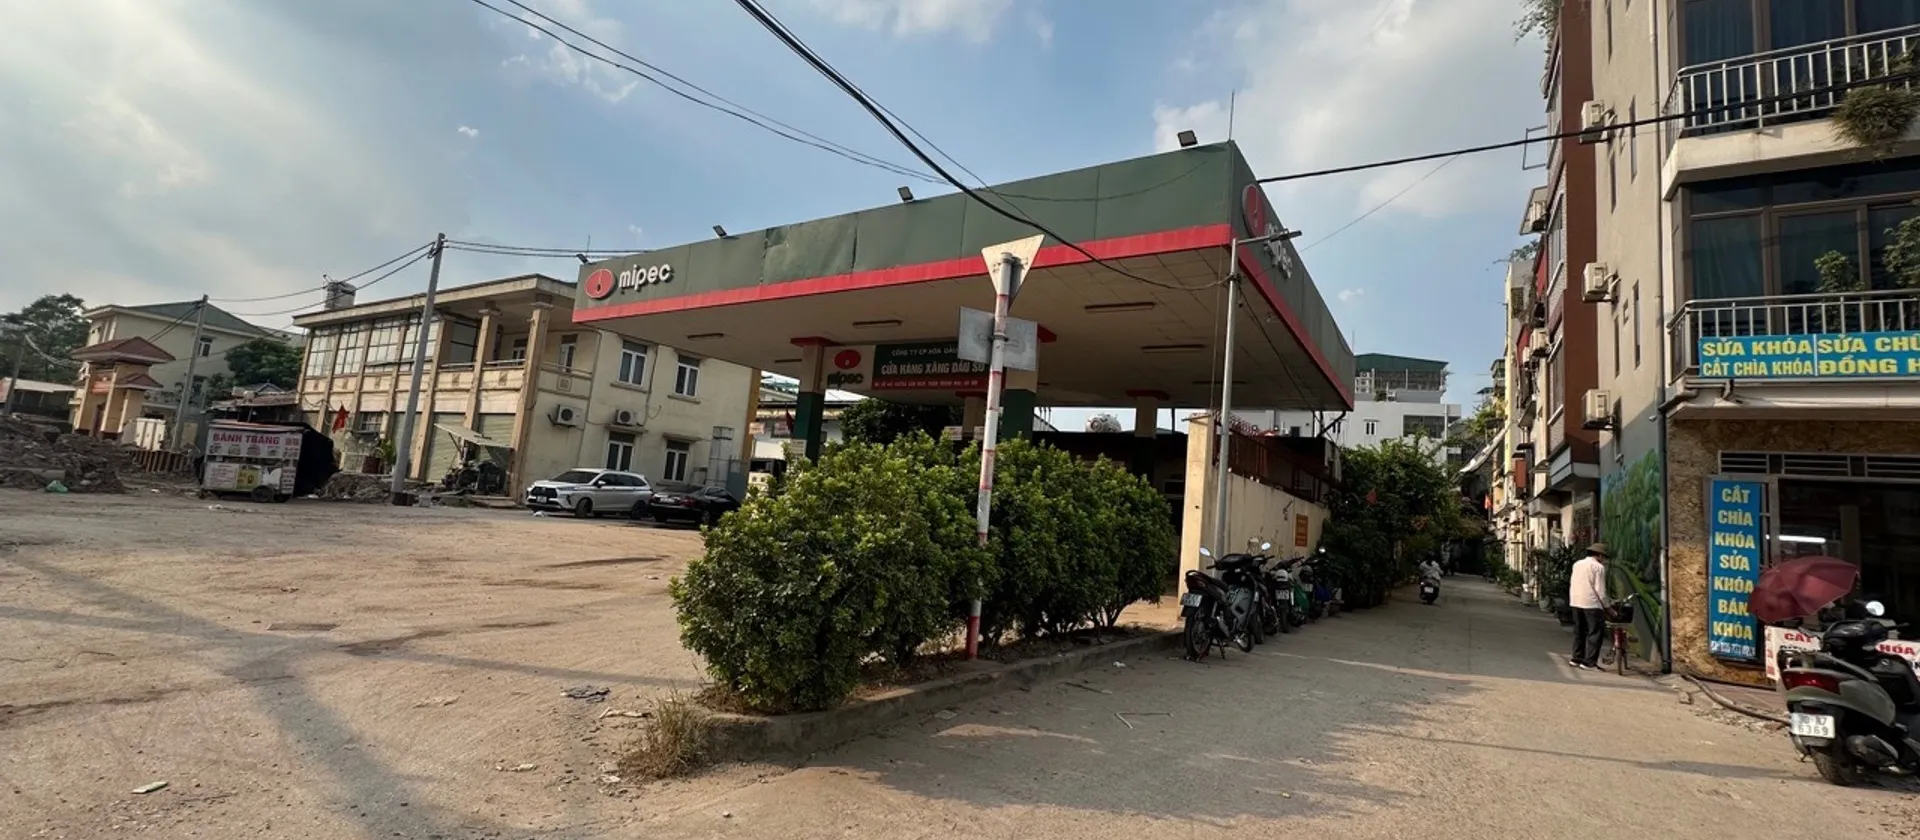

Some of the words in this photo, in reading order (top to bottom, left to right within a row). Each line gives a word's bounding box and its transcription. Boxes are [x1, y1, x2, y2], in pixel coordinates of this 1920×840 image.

[619, 264, 671, 290] mipec
[1702, 338, 1746, 356] SỬA
[1752, 338, 1813, 355] KHÓA
[1817, 334, 1868, 353] SỬA
[1733, 359, 1768, 376] CHÌA
[1772, 357, 1813, 375] KHÓA
[1819, 355, 1898, 375] ĐỒNG
[1717, 509, 1754, 526] CHÌA
[1715, 531, 1756, 549] KHÓA
[1719, 550, 1750, 571] SỬA
[1714, 575, 1754, 594] KHÓA
[1718, 598, 1750, 616] BÁN
[1713, 621, 1753, 640] KHÓA
